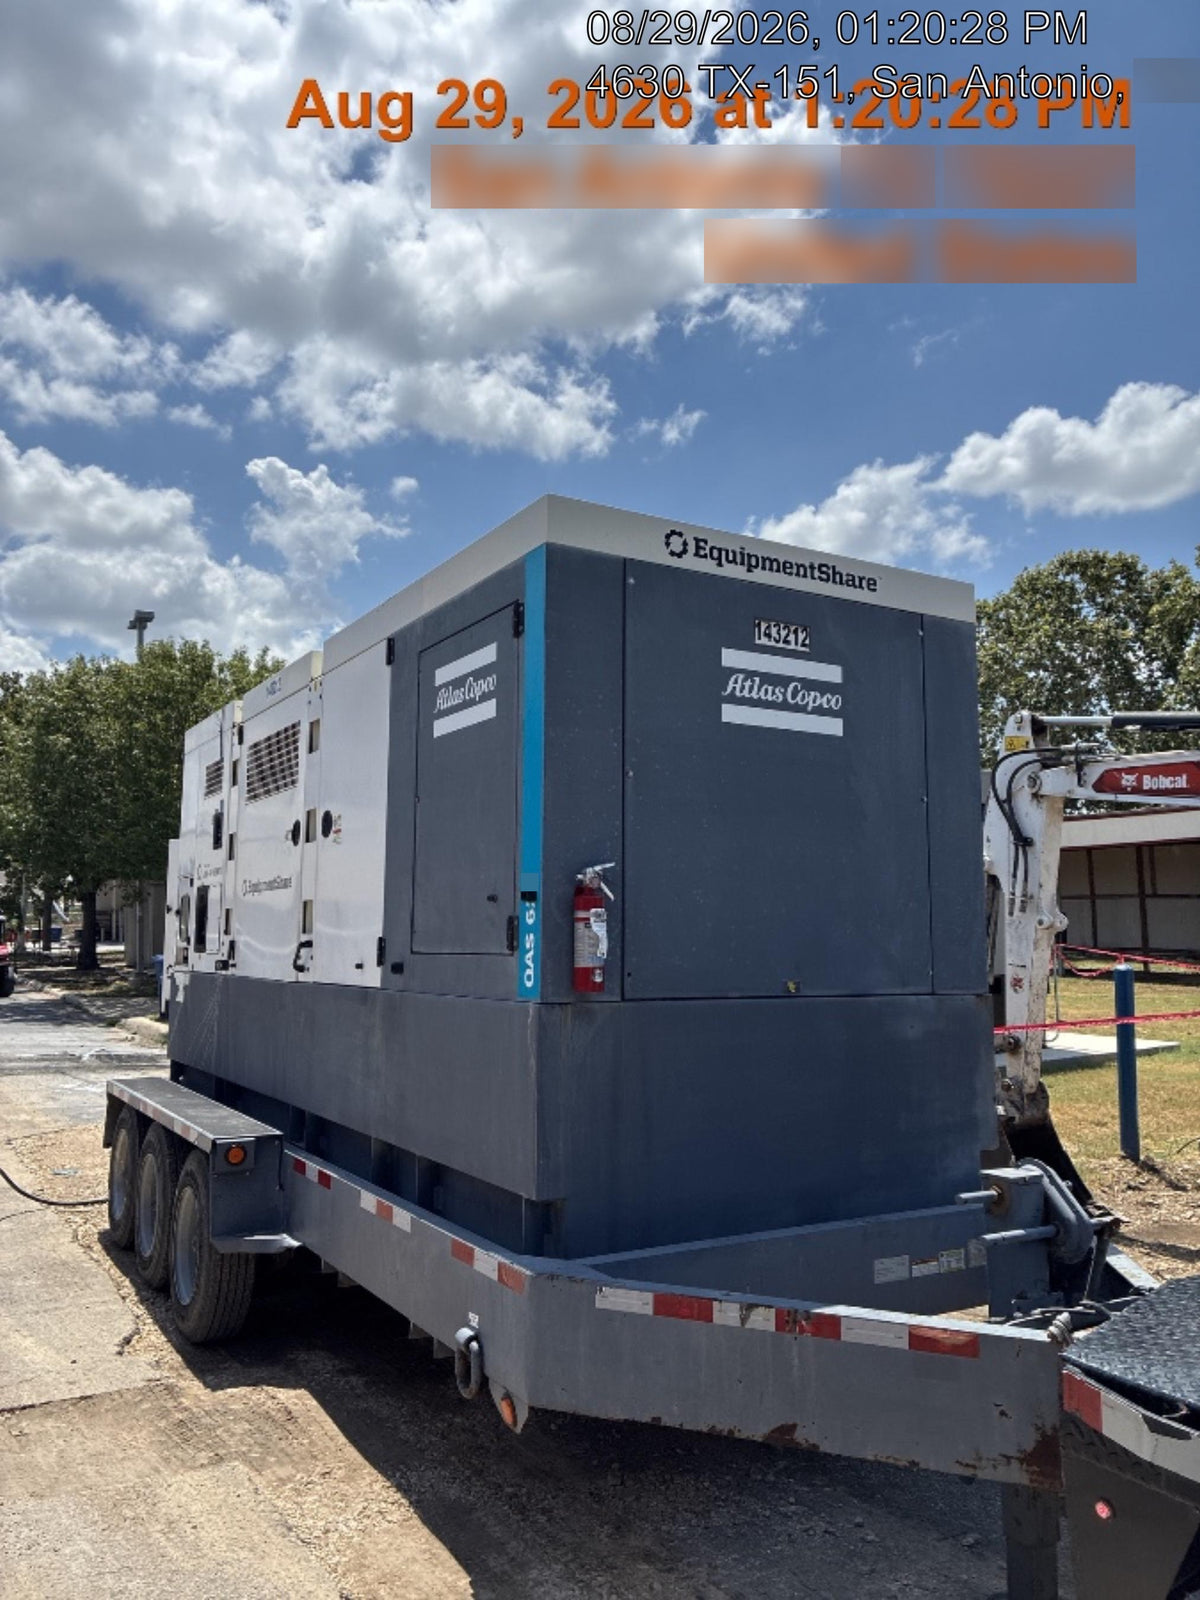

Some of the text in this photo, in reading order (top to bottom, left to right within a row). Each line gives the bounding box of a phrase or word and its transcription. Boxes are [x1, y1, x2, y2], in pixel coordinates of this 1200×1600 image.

[693, 536, 878, 593] EquipmentShare
[754, 619, 809, 648] 143212
[433, 674, 497, 714] Atlas Copco
[721, 672, 842, 712] Atlas Copco
[1142, 774, 1187, 790] Bobcat
[524, 932, 535, 988] QAS
